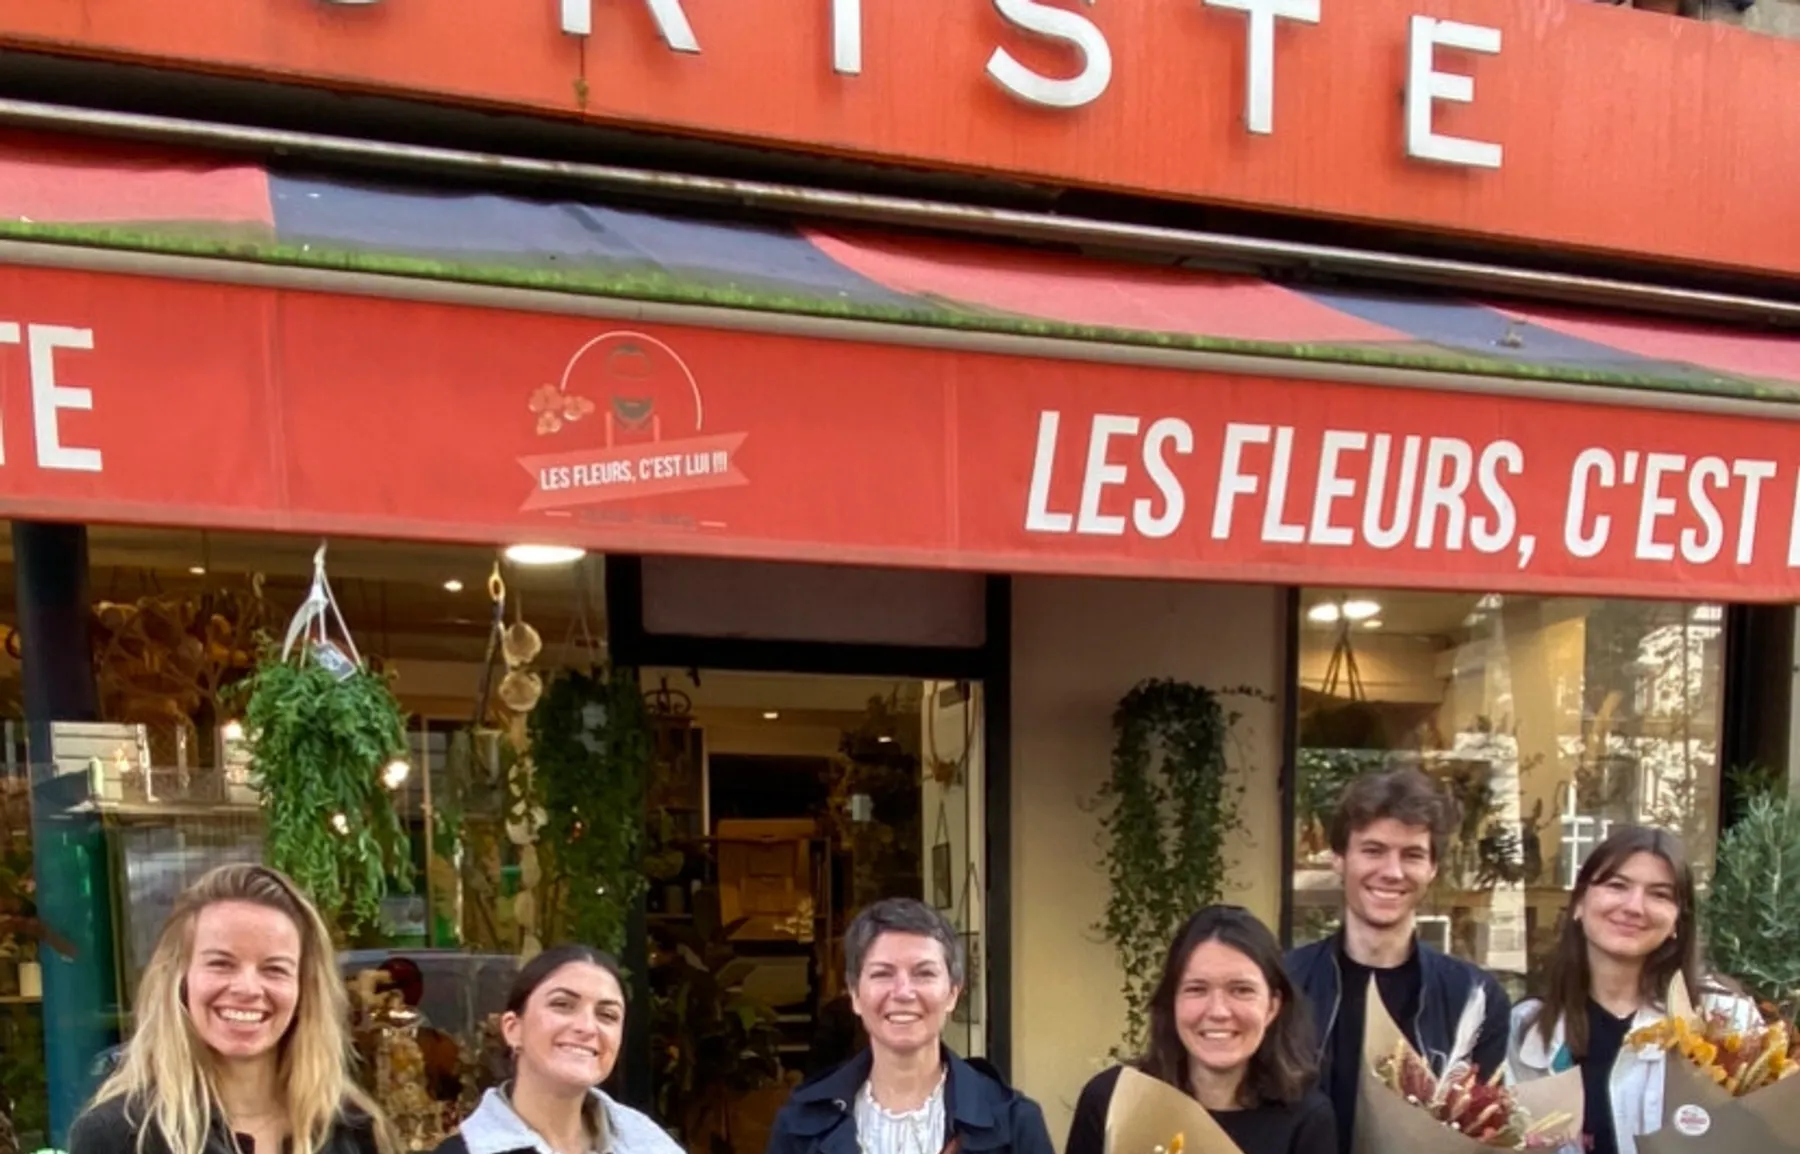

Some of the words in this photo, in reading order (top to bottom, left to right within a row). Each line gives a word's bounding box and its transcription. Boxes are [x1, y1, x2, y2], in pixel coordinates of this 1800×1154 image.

[318, 0, 1503, 169] ISTE
[540, 467, 571, 491] LES
[573, 460, 637, 487] FLEURS,
[639, 454, 682, 480] C'EST
[685, 452, 710, 476] LUI
[1025, 411, 1193, 538] LES
[1211, 423, 1536, 569] FLEURS,
[1564, 448, 1777, 565] C'EST
